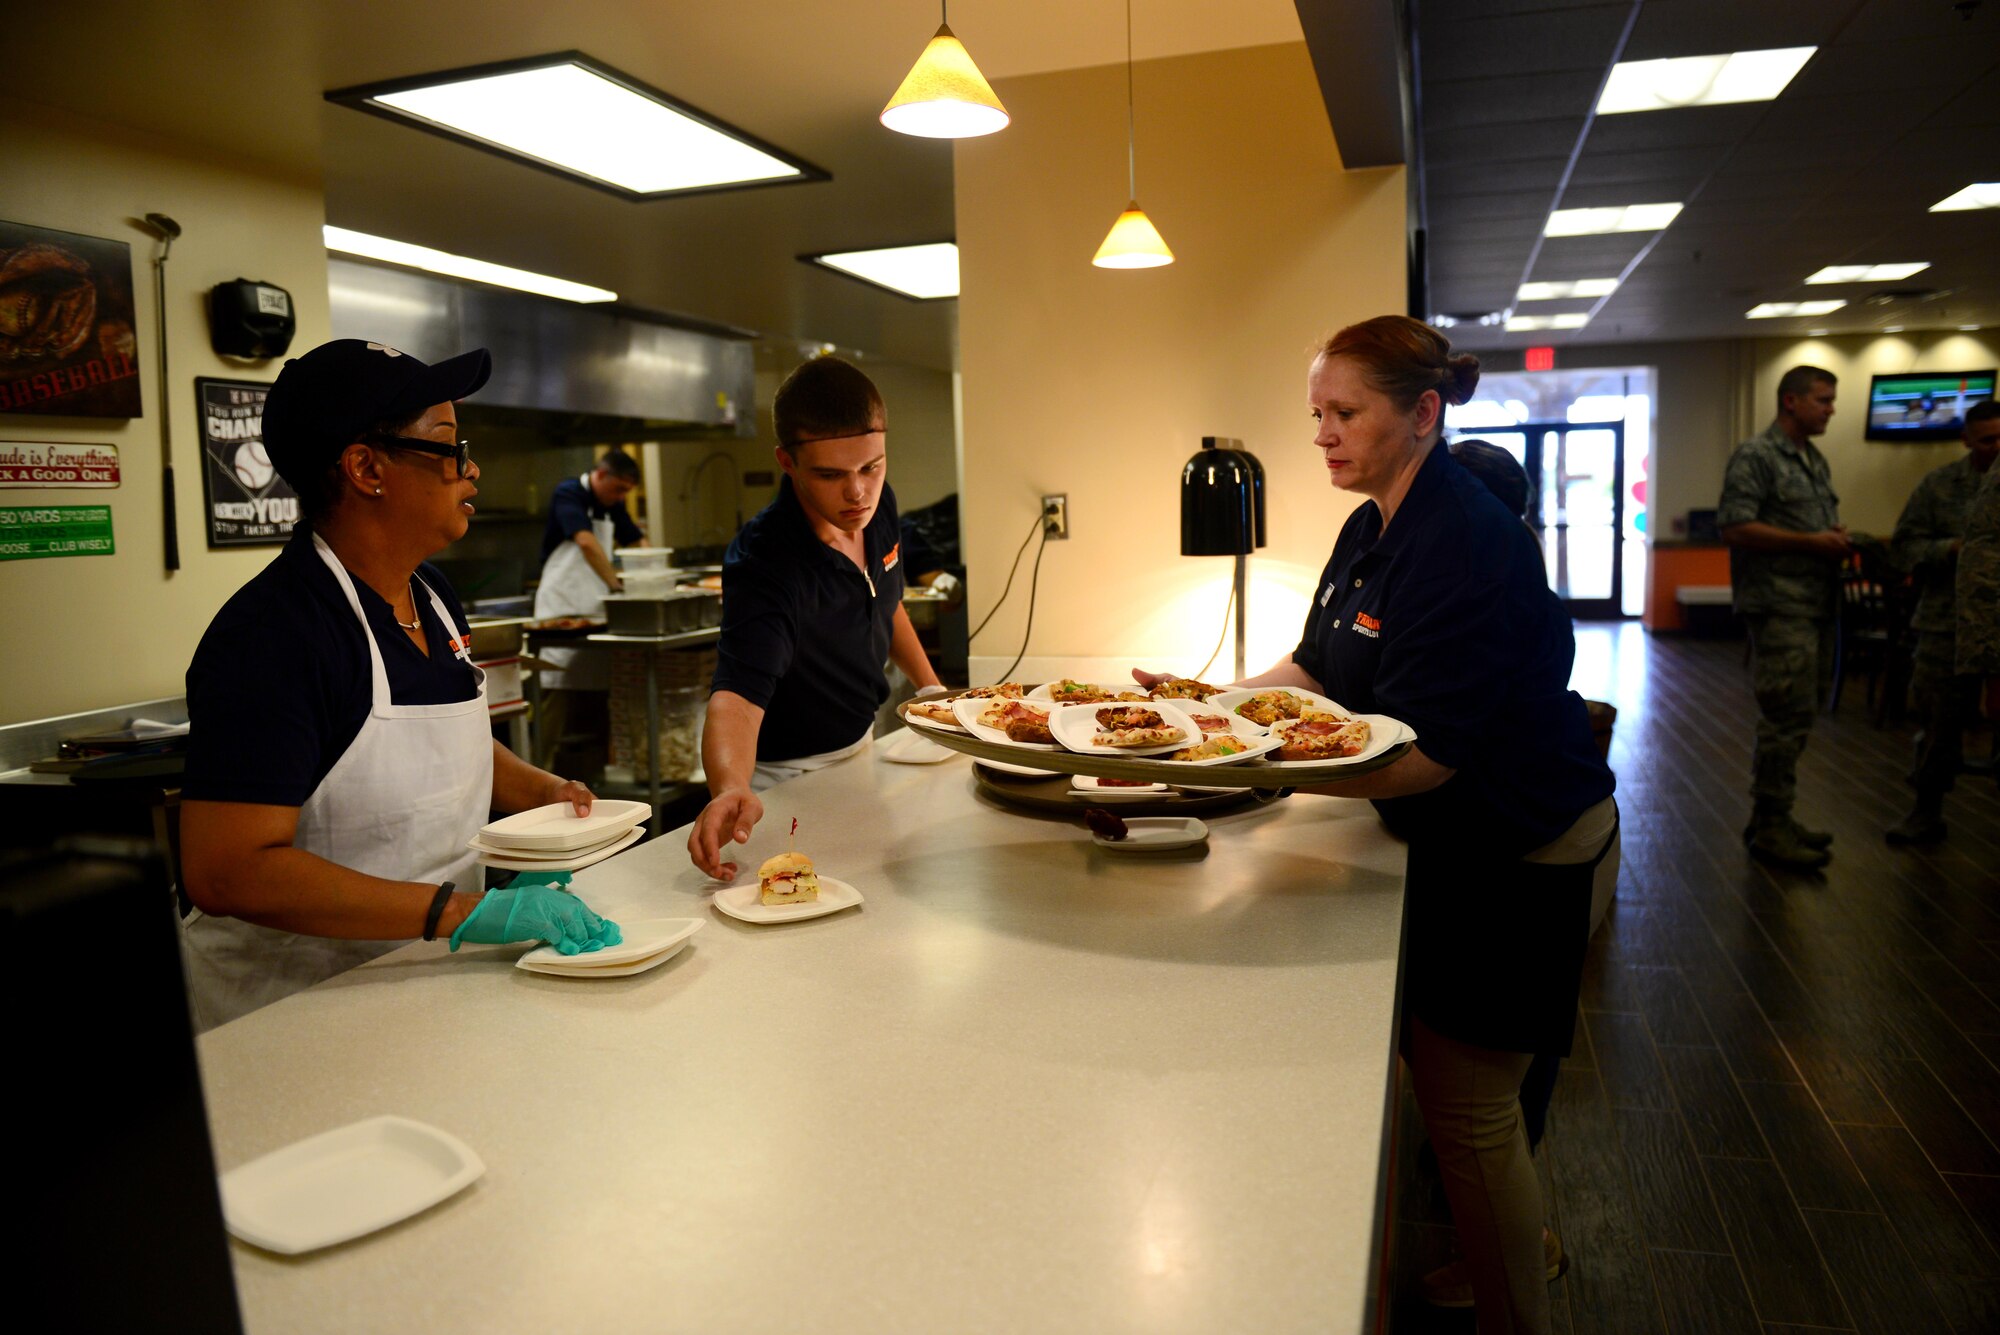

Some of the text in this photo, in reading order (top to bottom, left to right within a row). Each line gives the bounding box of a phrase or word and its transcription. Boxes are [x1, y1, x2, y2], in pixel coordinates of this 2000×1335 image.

[207, 416, 263, 439] CHAN
[30, 449, 43, 465] is
[19, 470, 30, 480] A
[32, 468, 77, 480] GOOD
[81, 469, 112, 480] ONE
[18, 510, 60, 523] YARDS
[252, 497, 298, 524] YOU
[215, 521, 238, 534] STOP
[243, 524, 275, 535] TAKING
[48, 541, 77, 552] CLUB
[77, 538, 111, 550] WISELY
